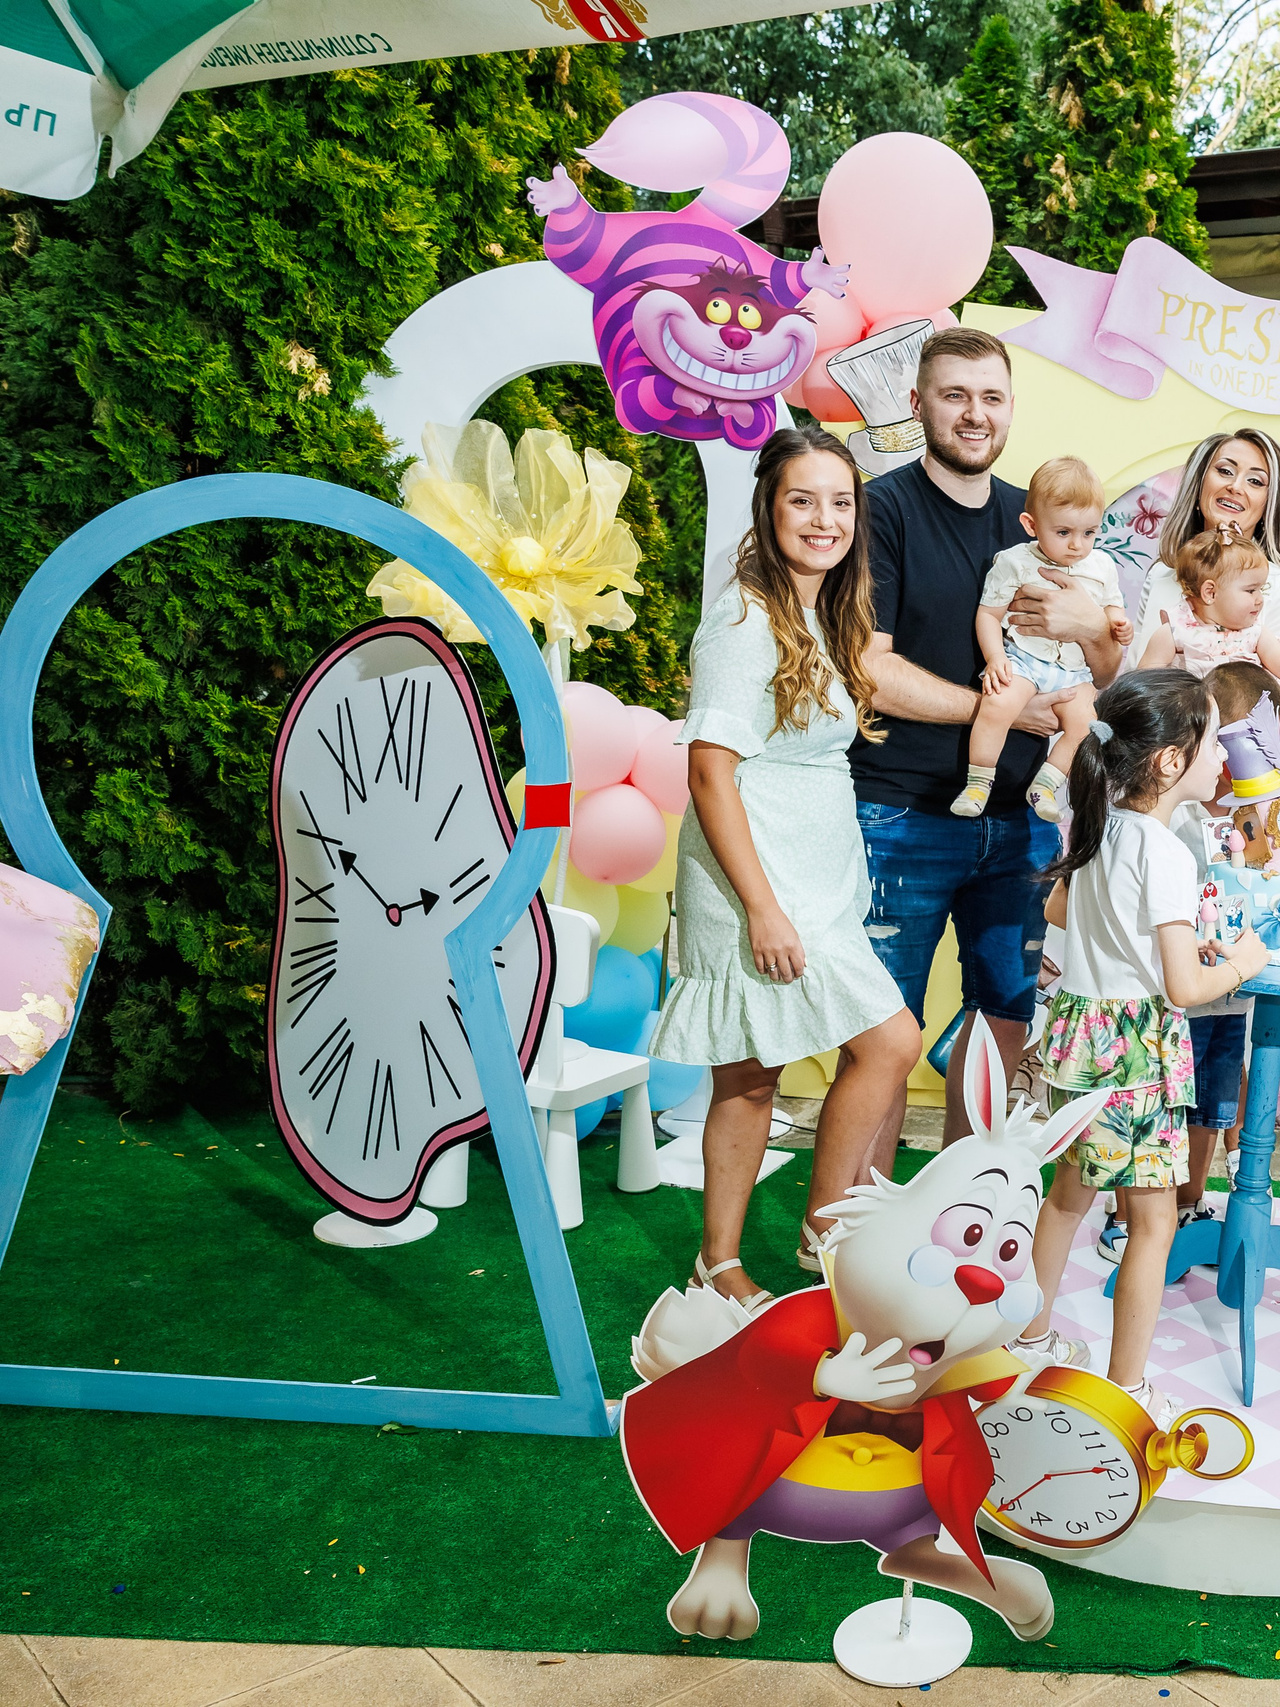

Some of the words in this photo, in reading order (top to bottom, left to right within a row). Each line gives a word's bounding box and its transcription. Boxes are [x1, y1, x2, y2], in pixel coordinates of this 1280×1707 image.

[1188, 360, 1204, 377] IN
[1007, 1406, 1033, 1422] 9
[1044, 1409, 1072, 1434] 10
[982, 1422, 1009, 1438] 8
[1079, 1429, 1106, 1451] 11
[1100, 1457, 1129, 1482] 12
[1108, 1491, 1129, 1500] 1
[1030, 1511, 1053, 1527] 4
[1095, 1509, 1118, 1524] 2
[1066, 1520, 1089, 1535] 3
